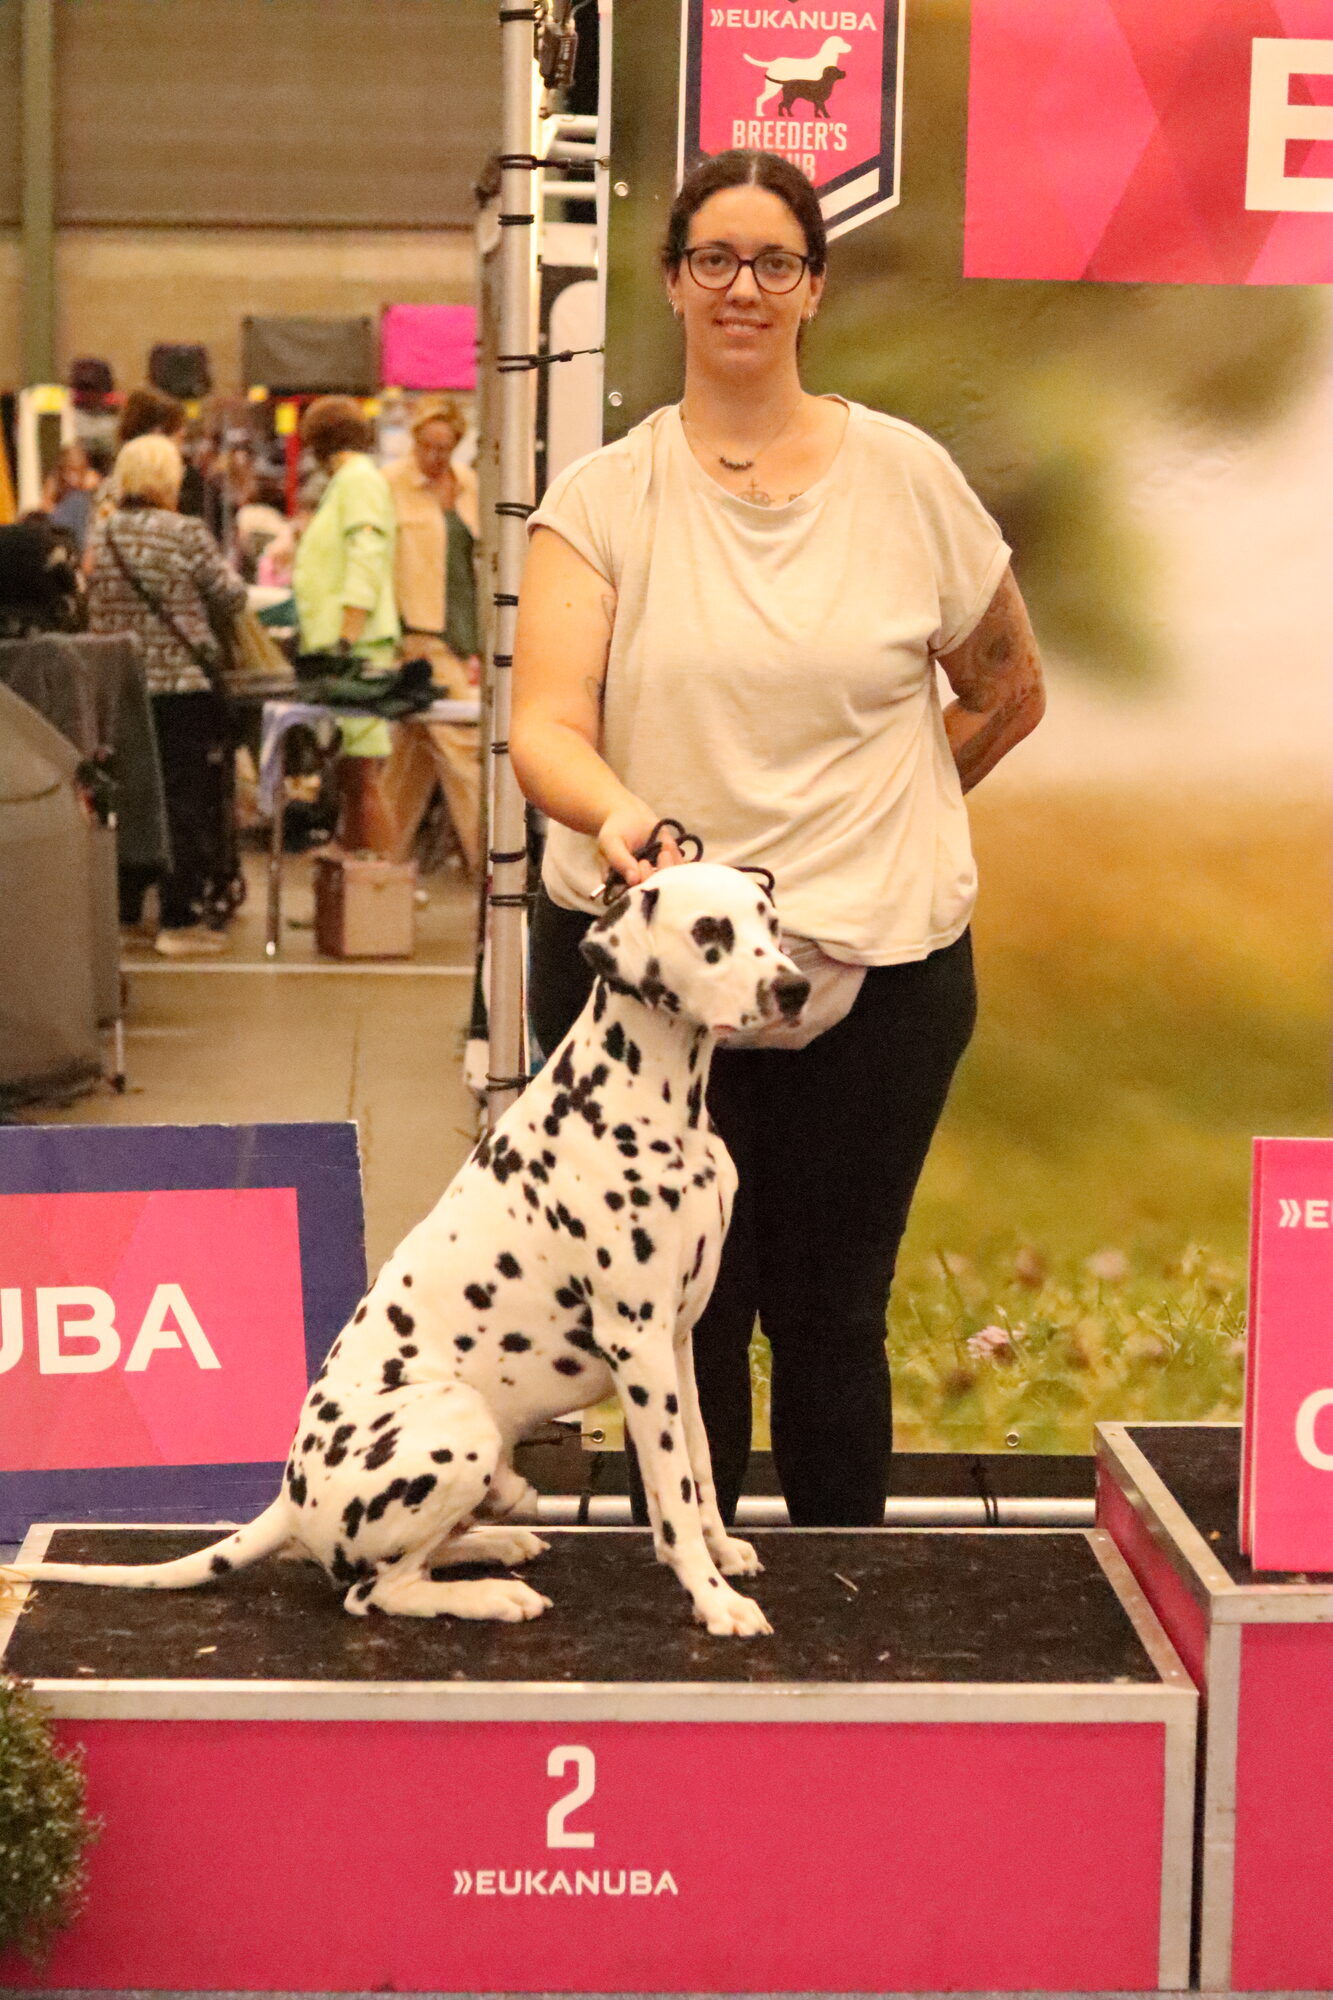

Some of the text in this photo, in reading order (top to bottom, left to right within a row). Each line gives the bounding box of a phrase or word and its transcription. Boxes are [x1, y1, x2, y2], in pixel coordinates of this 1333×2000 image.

[726, 9, 877, 32] EUKANUBA
[732, 119, 847, 151] BREEDER'S
[547, 1745, 595, 1848] 2
[476, 1870, 678, 1895] EUKANUBA
